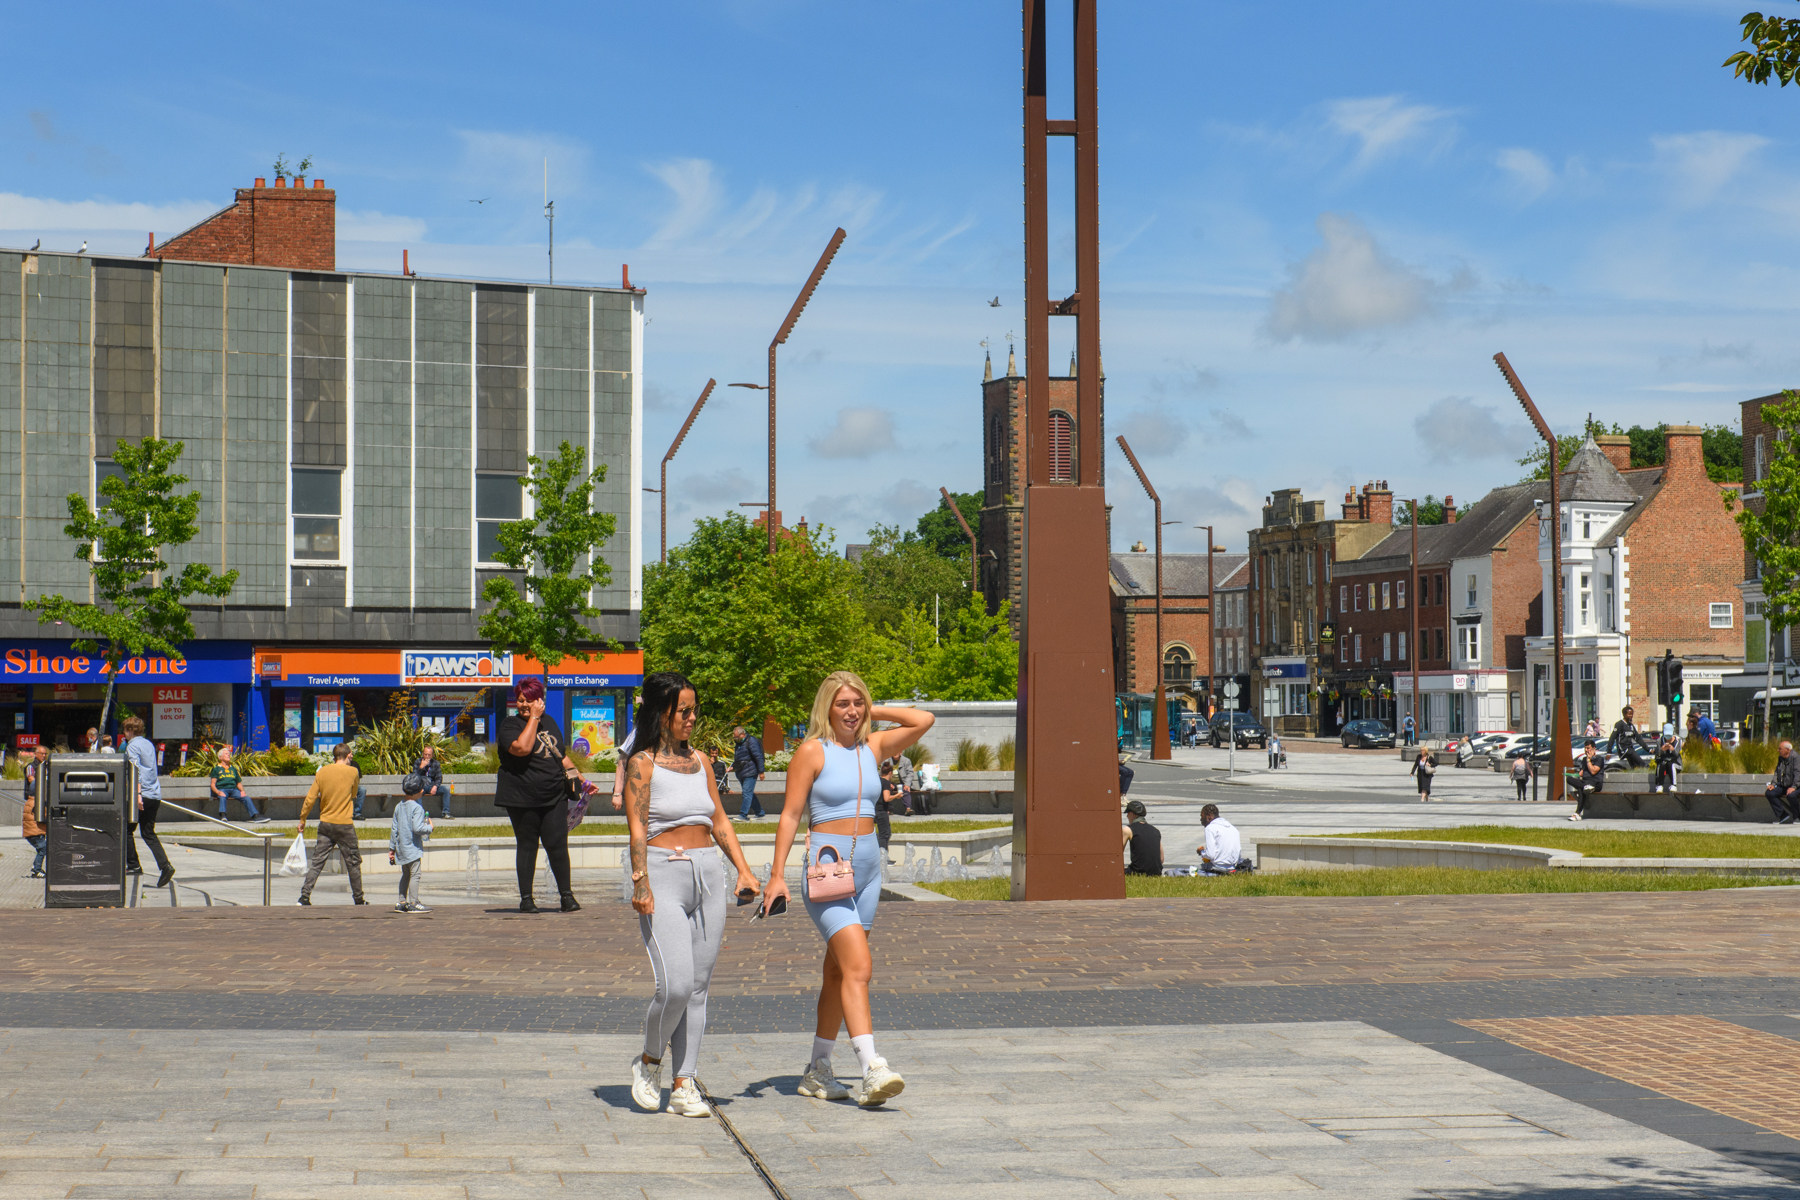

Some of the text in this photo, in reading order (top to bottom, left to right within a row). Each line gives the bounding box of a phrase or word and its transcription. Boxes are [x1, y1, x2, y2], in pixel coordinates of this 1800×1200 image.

[5, 648, 187, 675] Shoe Zone
[415, 657, 510, 676] DAWSON
[308, 676, 360, 686] Travel Agents
[547, 676, 609, 686] Foreign Exchange
[158, 690, 188, 700] SALE
[580, 710, 606, 720] Holiday!
[20, 737, 37, 745] SALE
